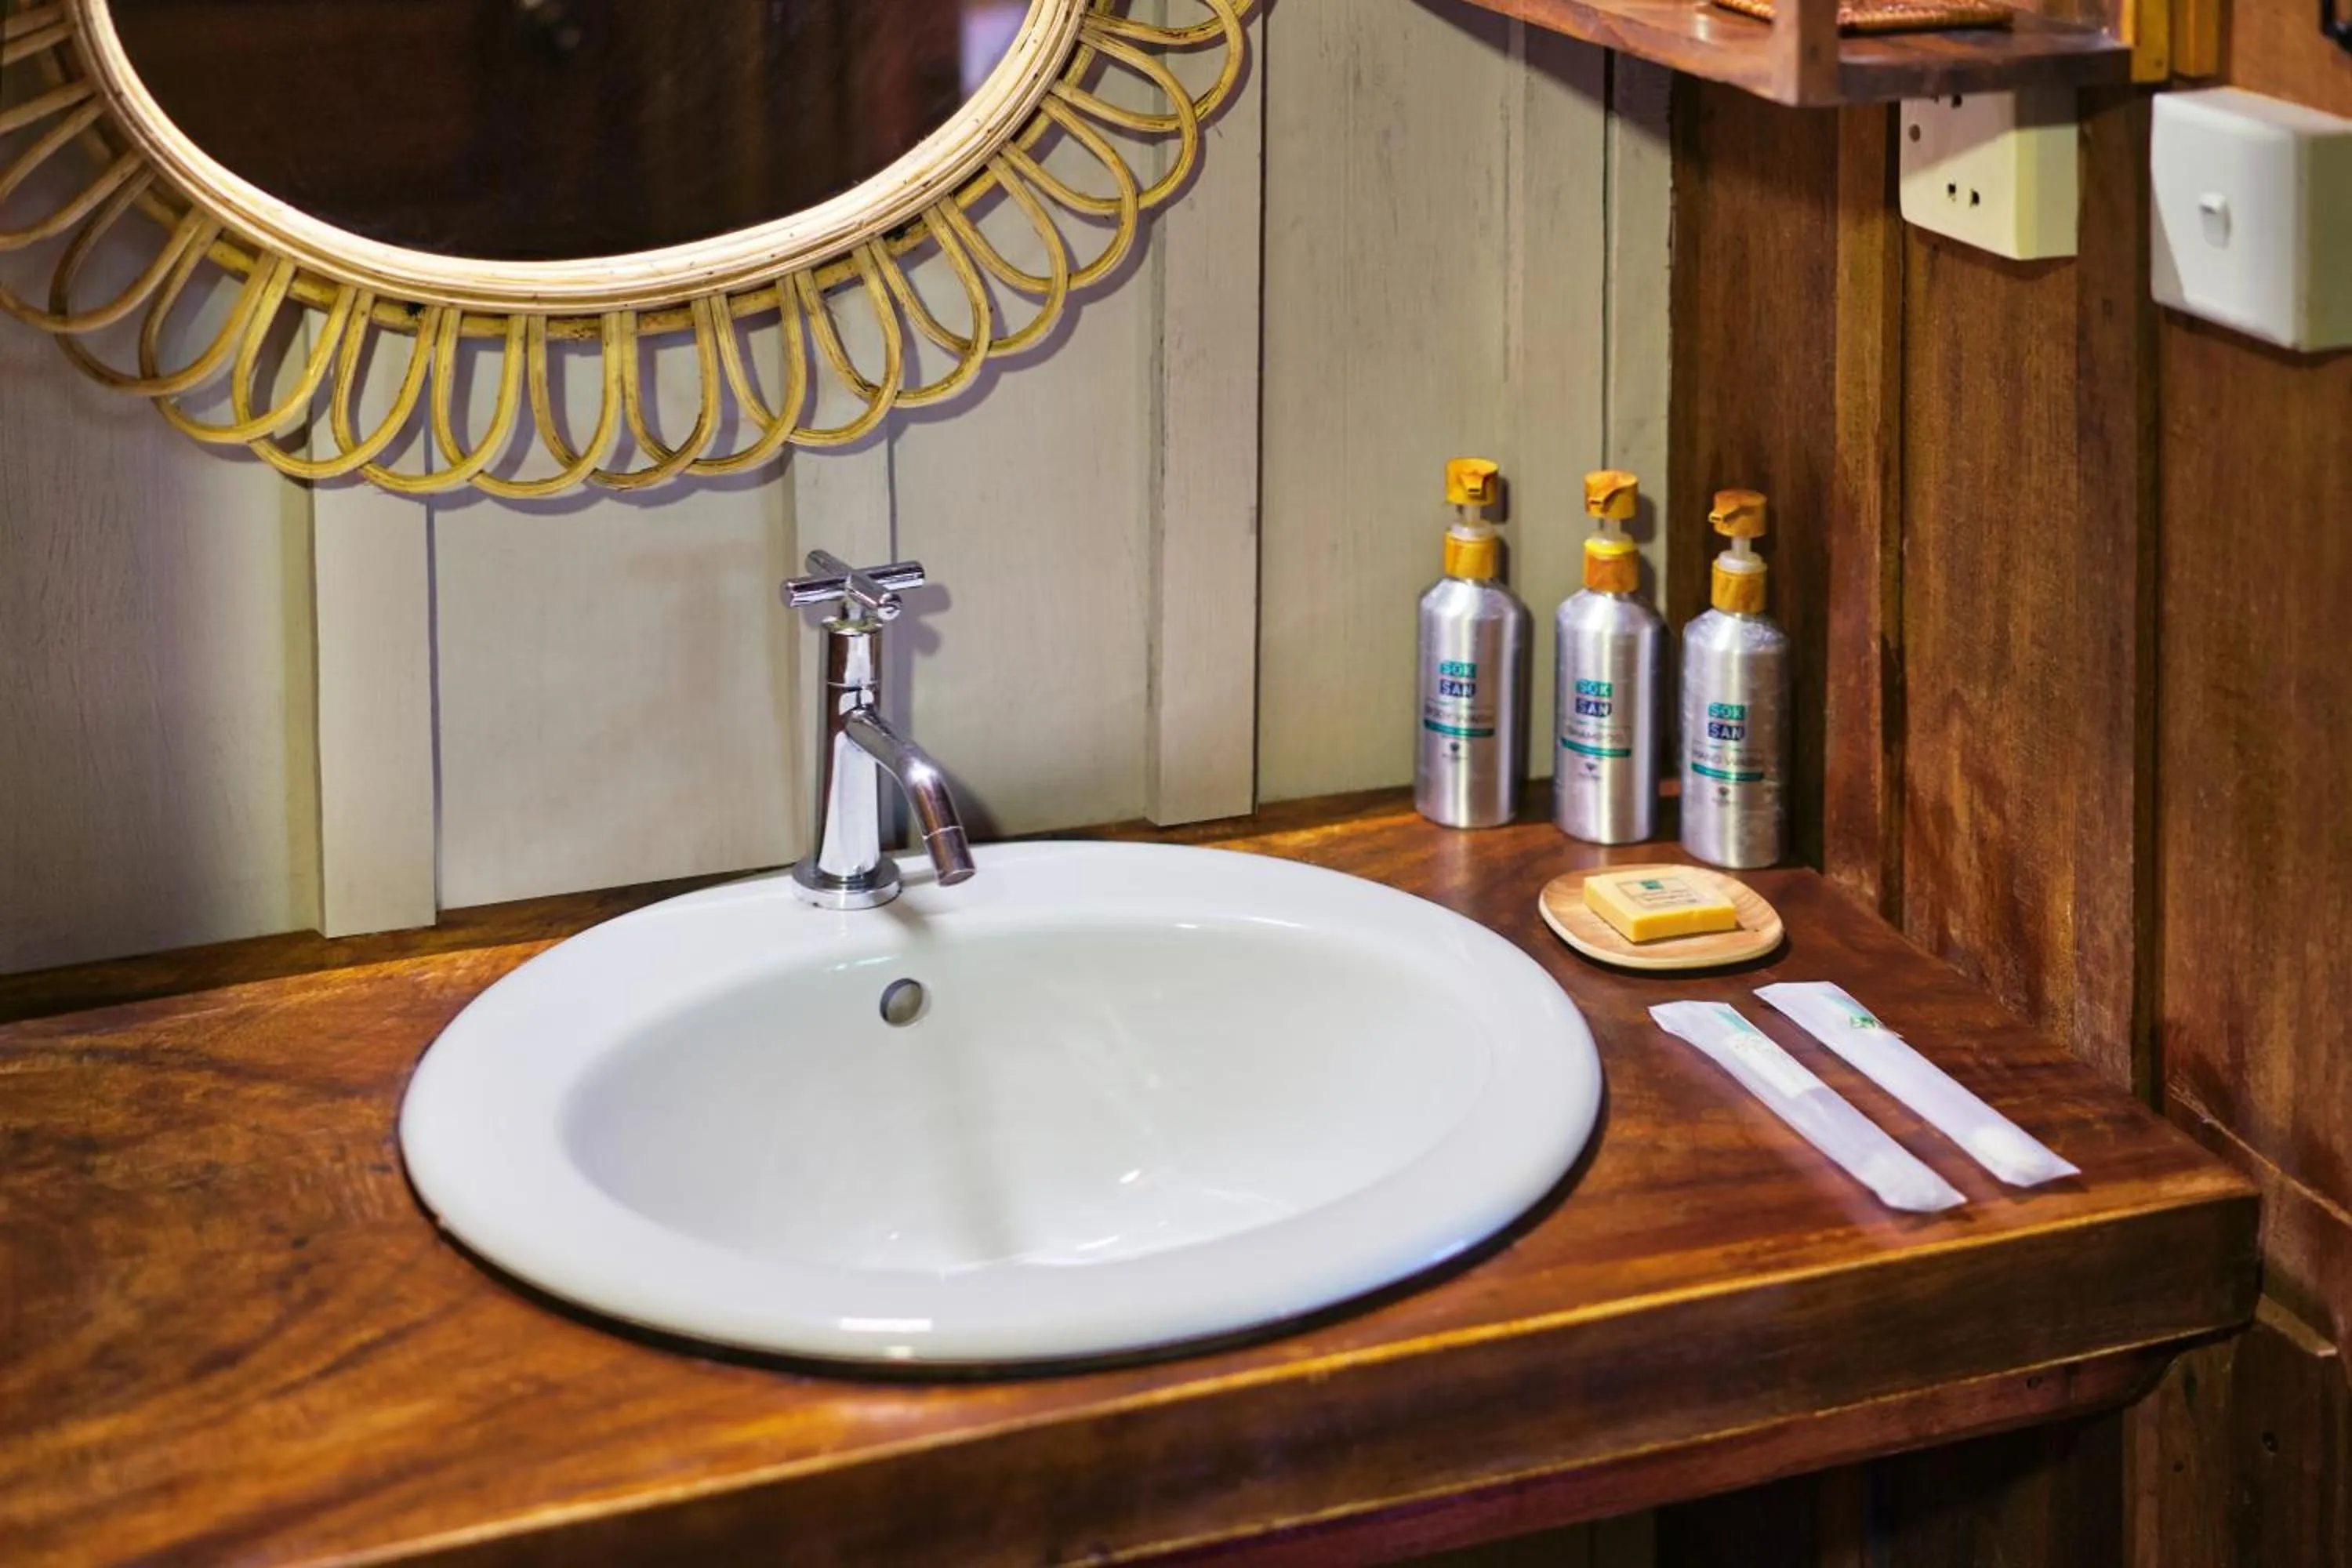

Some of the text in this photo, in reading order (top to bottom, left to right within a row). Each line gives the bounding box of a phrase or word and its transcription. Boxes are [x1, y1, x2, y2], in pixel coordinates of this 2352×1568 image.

[1439, 662, 1475, 677] SOK
[1441, 681, 1474, 696] SAN
[1577, 681, 1611, 696] SOK
[1577, 699, 1610, 715] SAN
[1710, 704, 1744, 719] SOK
[1710, 724, 1743, 739] SAN
